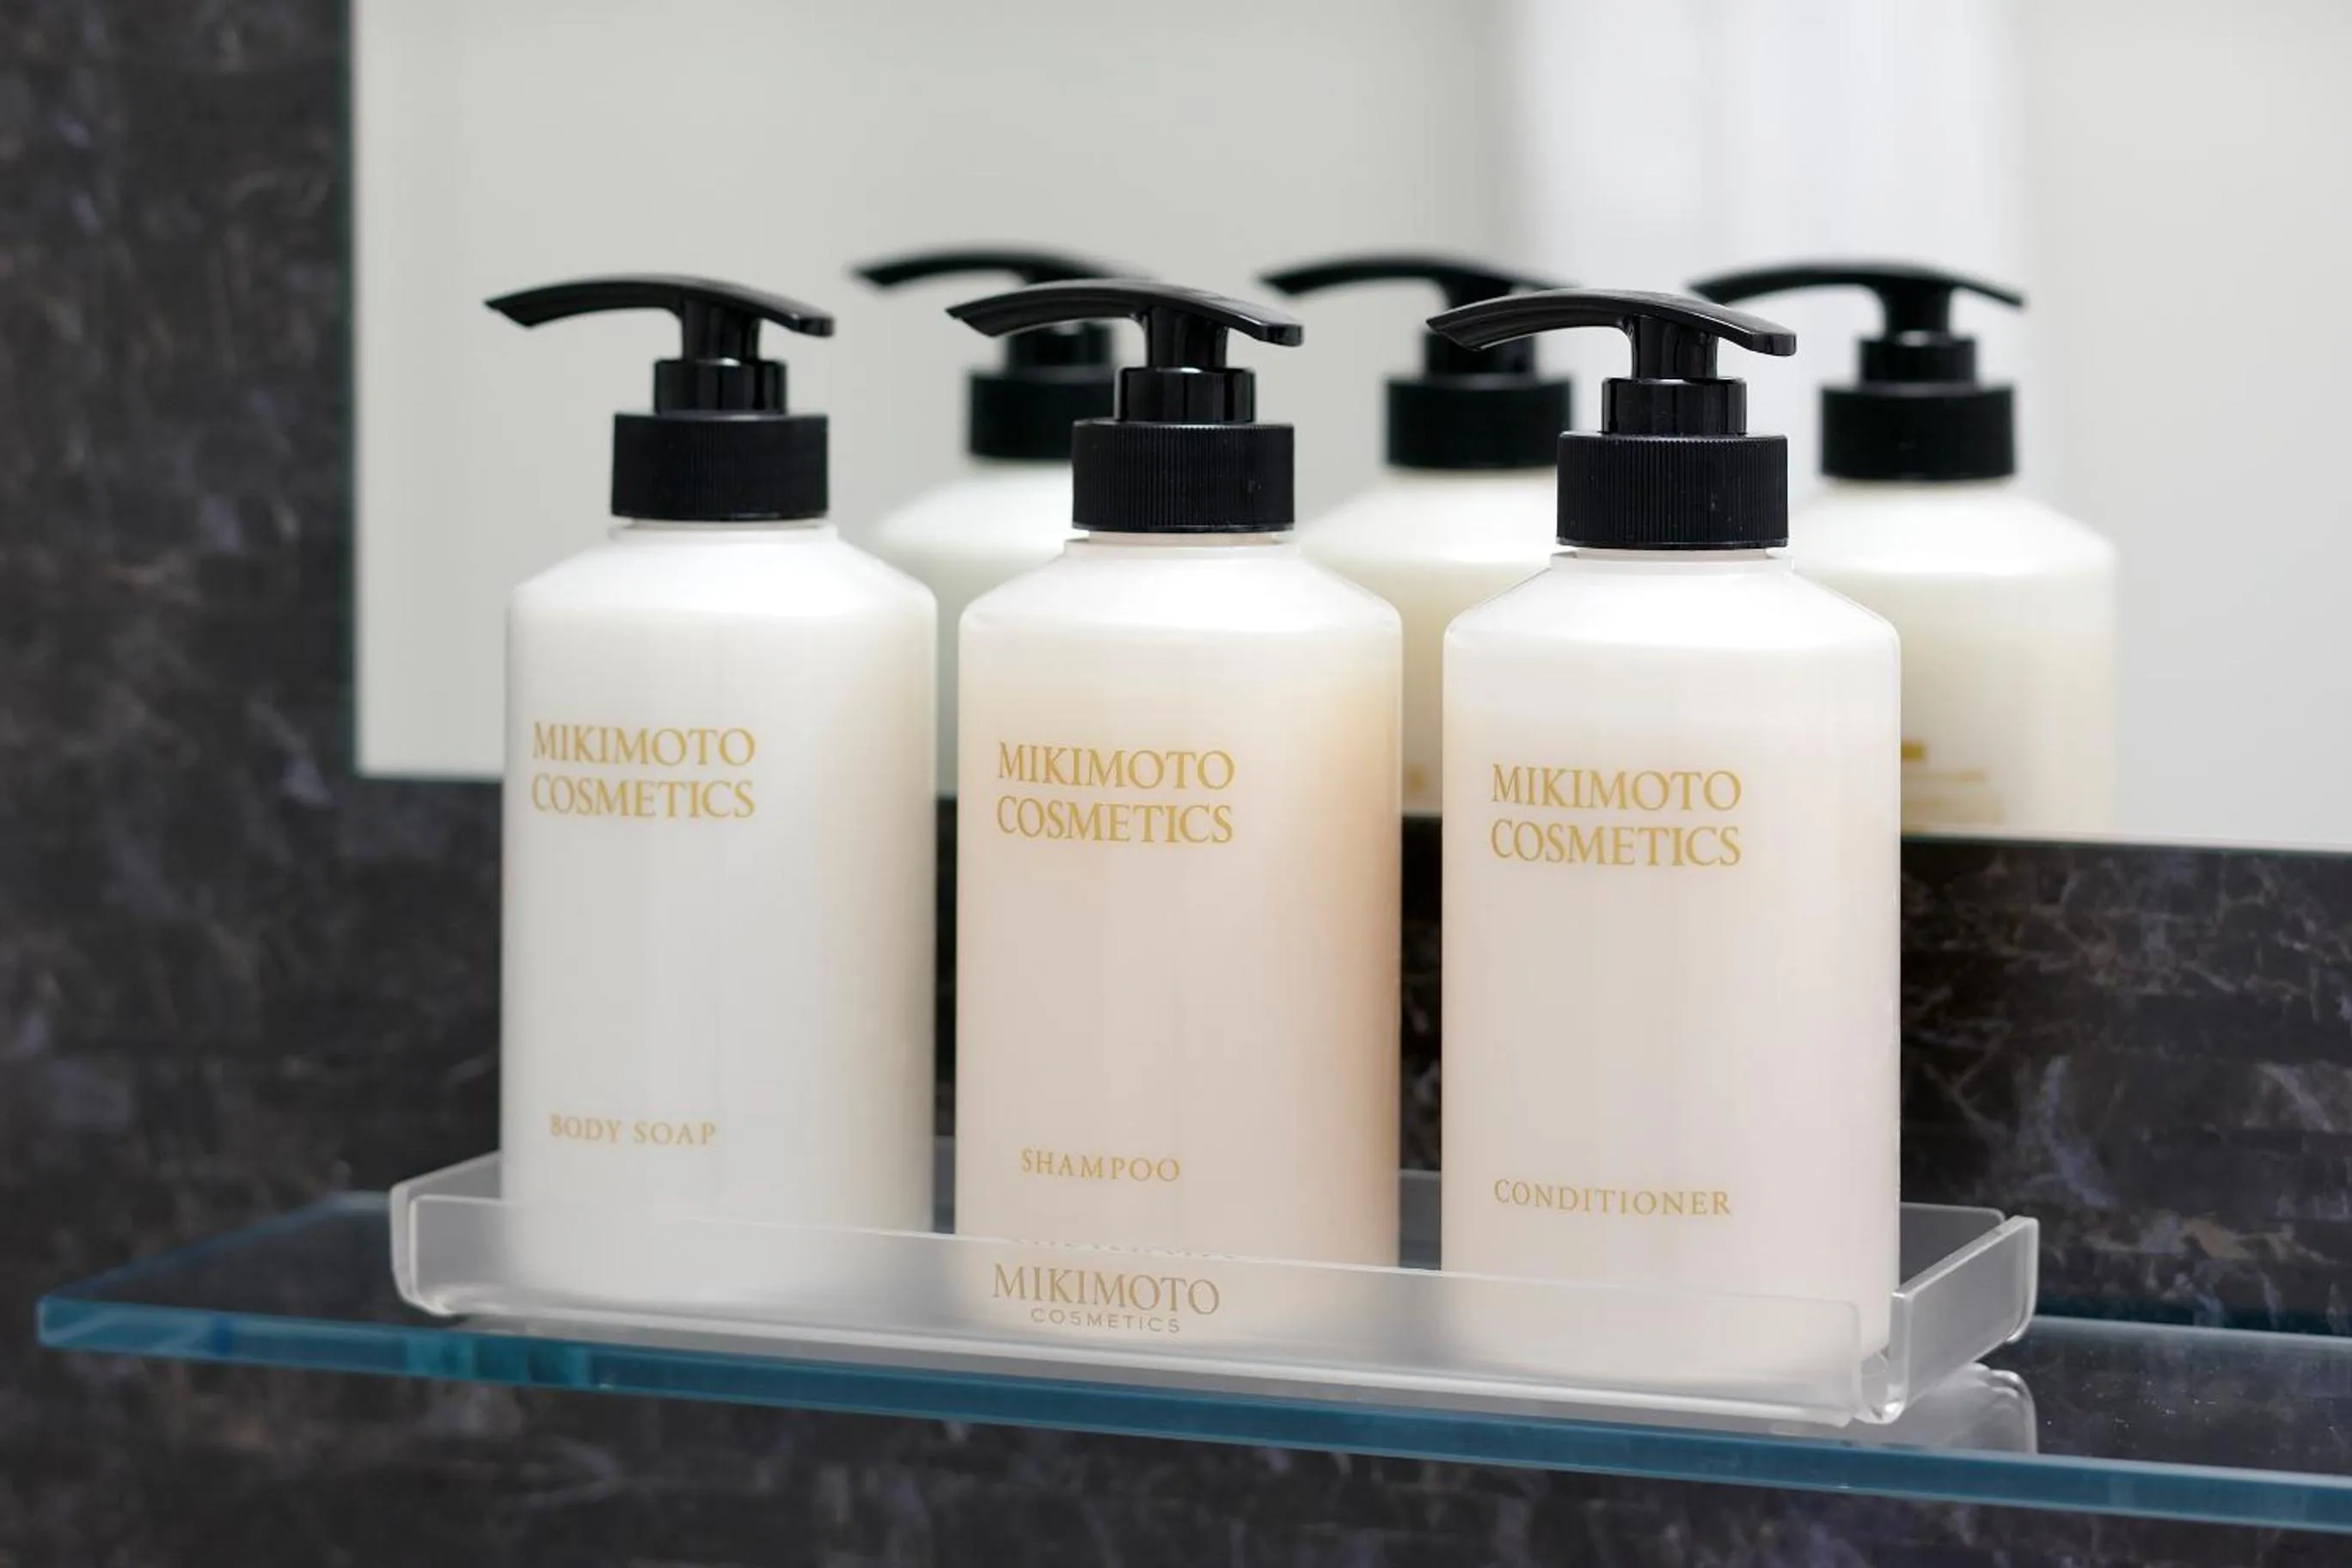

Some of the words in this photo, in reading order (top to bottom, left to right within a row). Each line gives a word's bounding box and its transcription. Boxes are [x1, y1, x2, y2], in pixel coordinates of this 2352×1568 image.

[532, 721, 756, 767] MIKIMOTO
[998, 741, 1235, 790] MIKIMOTO
[531, 774, 756, 818] COSMETICS
[1491, 763, 1742, 812] MIKIMOTO
[996, 795, 1234, 844] COSMETICS
[1491, 818, 1741, 867] COSMETICS
[550, 1114, 622, 1142] BODY
[633, 1122, 717, 1146] SOAP
[1020, 1148, 1181, 1182] SHAMPOO
[1494, 1179, 1731, 1216] CONDITIONER
[993, 1264, 1221, 1316] MIKIMOTO
[1030, 1308, 1181, 1334] COSMETICS
